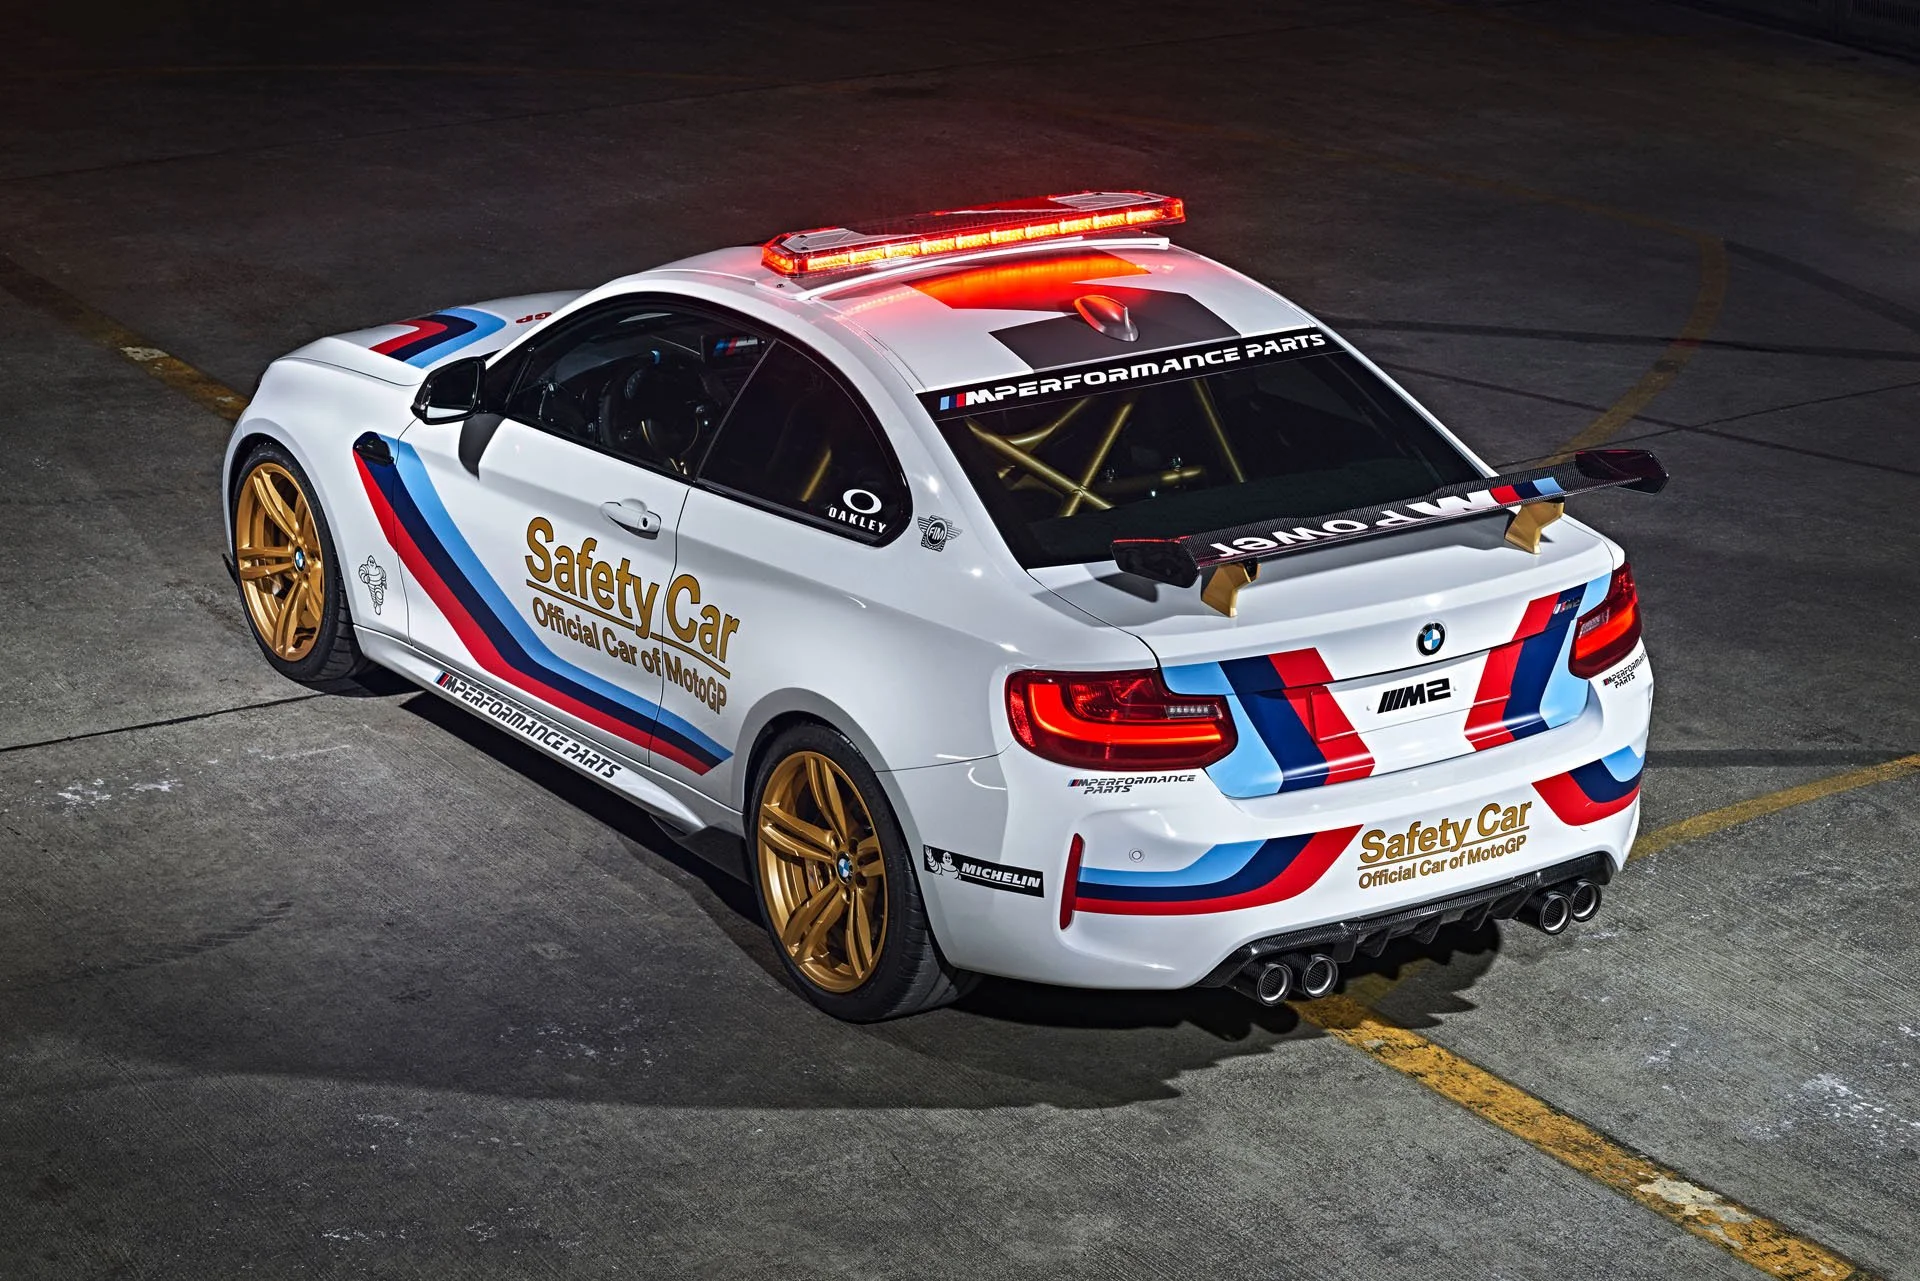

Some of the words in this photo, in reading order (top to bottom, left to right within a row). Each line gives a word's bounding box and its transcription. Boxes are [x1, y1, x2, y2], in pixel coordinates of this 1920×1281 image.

[1247, 334, 1326, 359] PARTS
[828, 506, 887, 534] OAKLEY
[928, 526, 945, 541] FIM
[524, 516, 660, 639] Safety
[666, 573, 741, 664] Car
[532, 596, 601, 651] Official
[602, 627, 638, 667] Car
[641, 647, 662, 676] of
[663, 650, 728, 715] MotoGP
[1614, 672, 1636, 689] PARTS
[563, 742, 622, 779] PARTS
[1083, 785, 1133, 795] PARTS
[1359, 817, 1473, 864] Safety
[1477, 801, 1533, 837] Car
[961, 862, 1041, 888] MICHELIN
[1358, 862, 1416, 890] Official
[1419, 858, 1448, 876] Car
[1449, 851, 1466, 870] of
[1467, 834, 1527, 865] MotoGP
